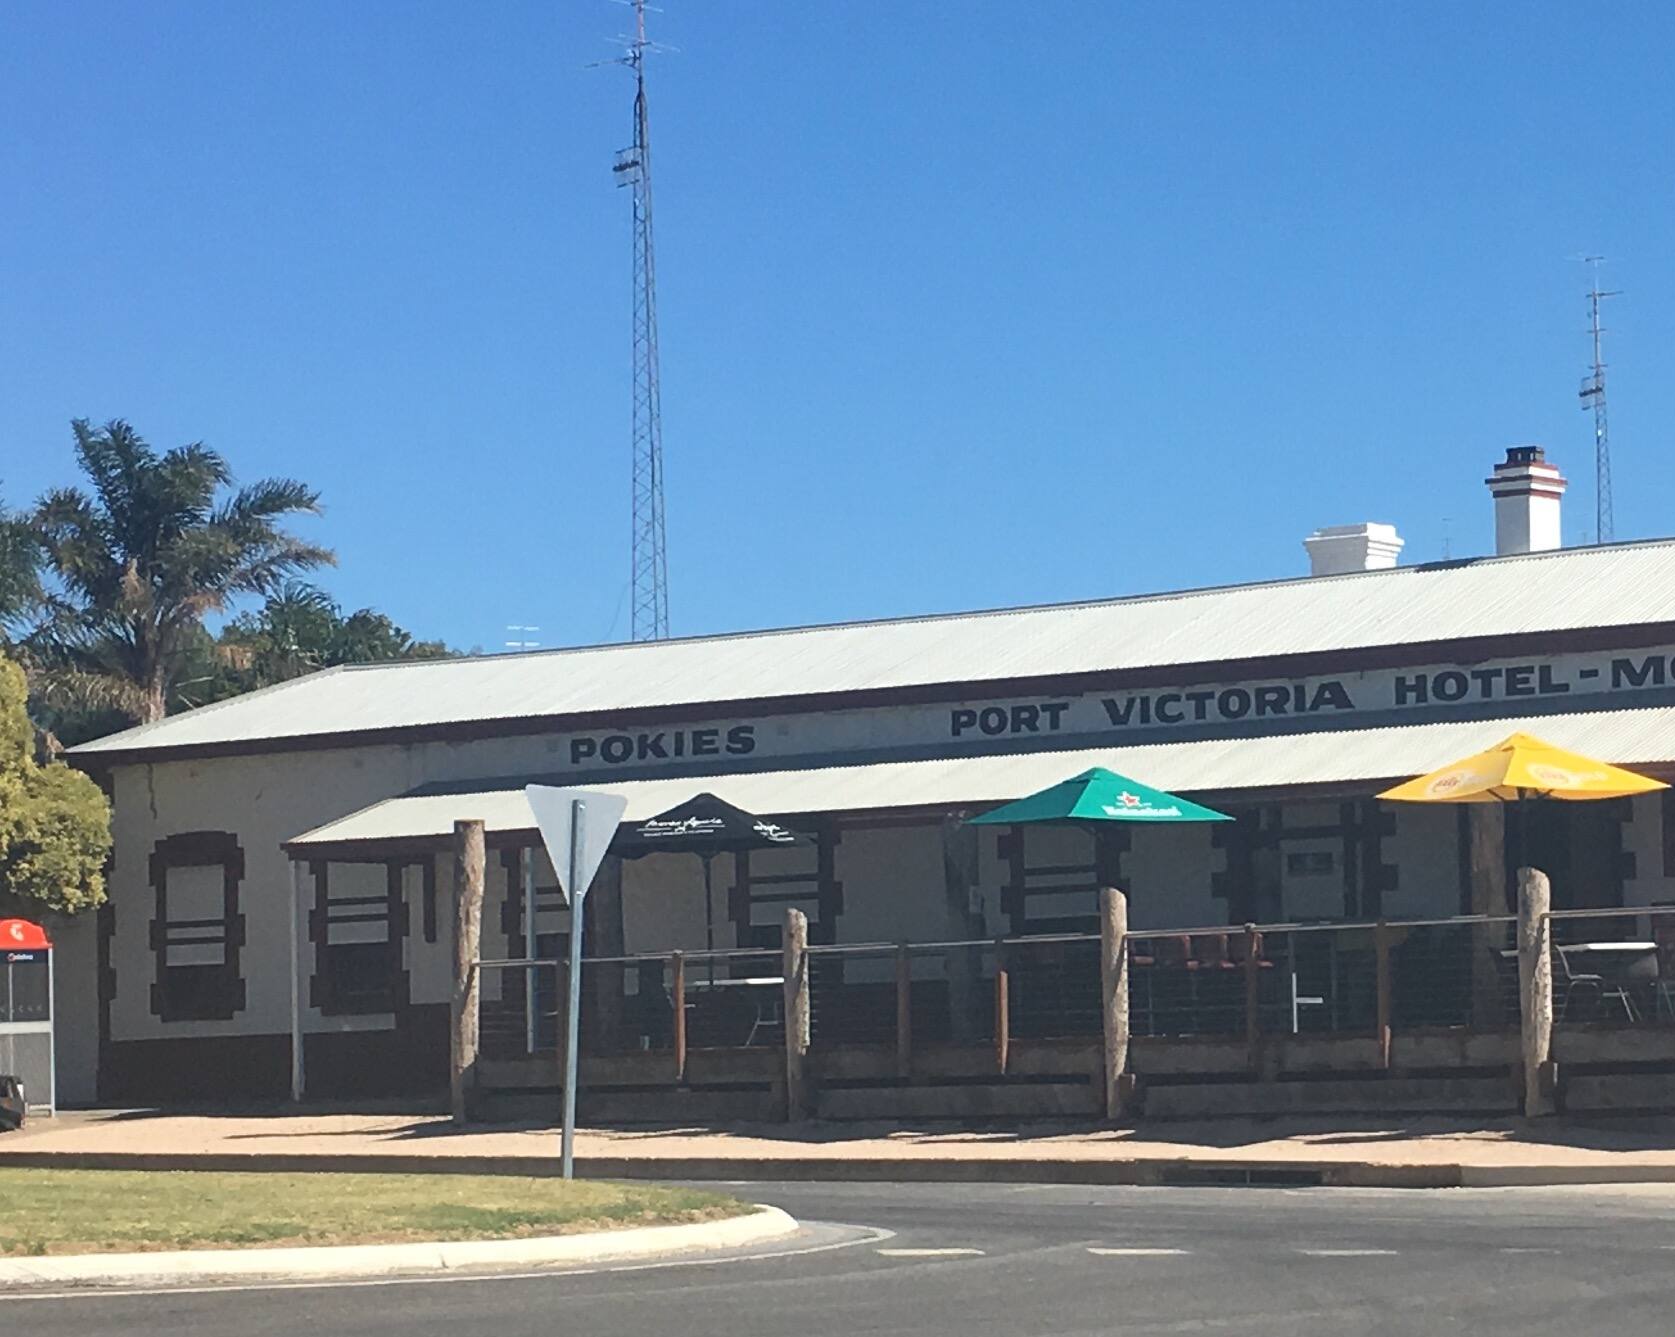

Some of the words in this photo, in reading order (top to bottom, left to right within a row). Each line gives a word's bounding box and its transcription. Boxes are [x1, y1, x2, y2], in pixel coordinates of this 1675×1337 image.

[951, 702, 1070, 737] PORT
[1101, 680, 1356, 726] VICTORIA
[570, 725, 756, 765] POKIES
